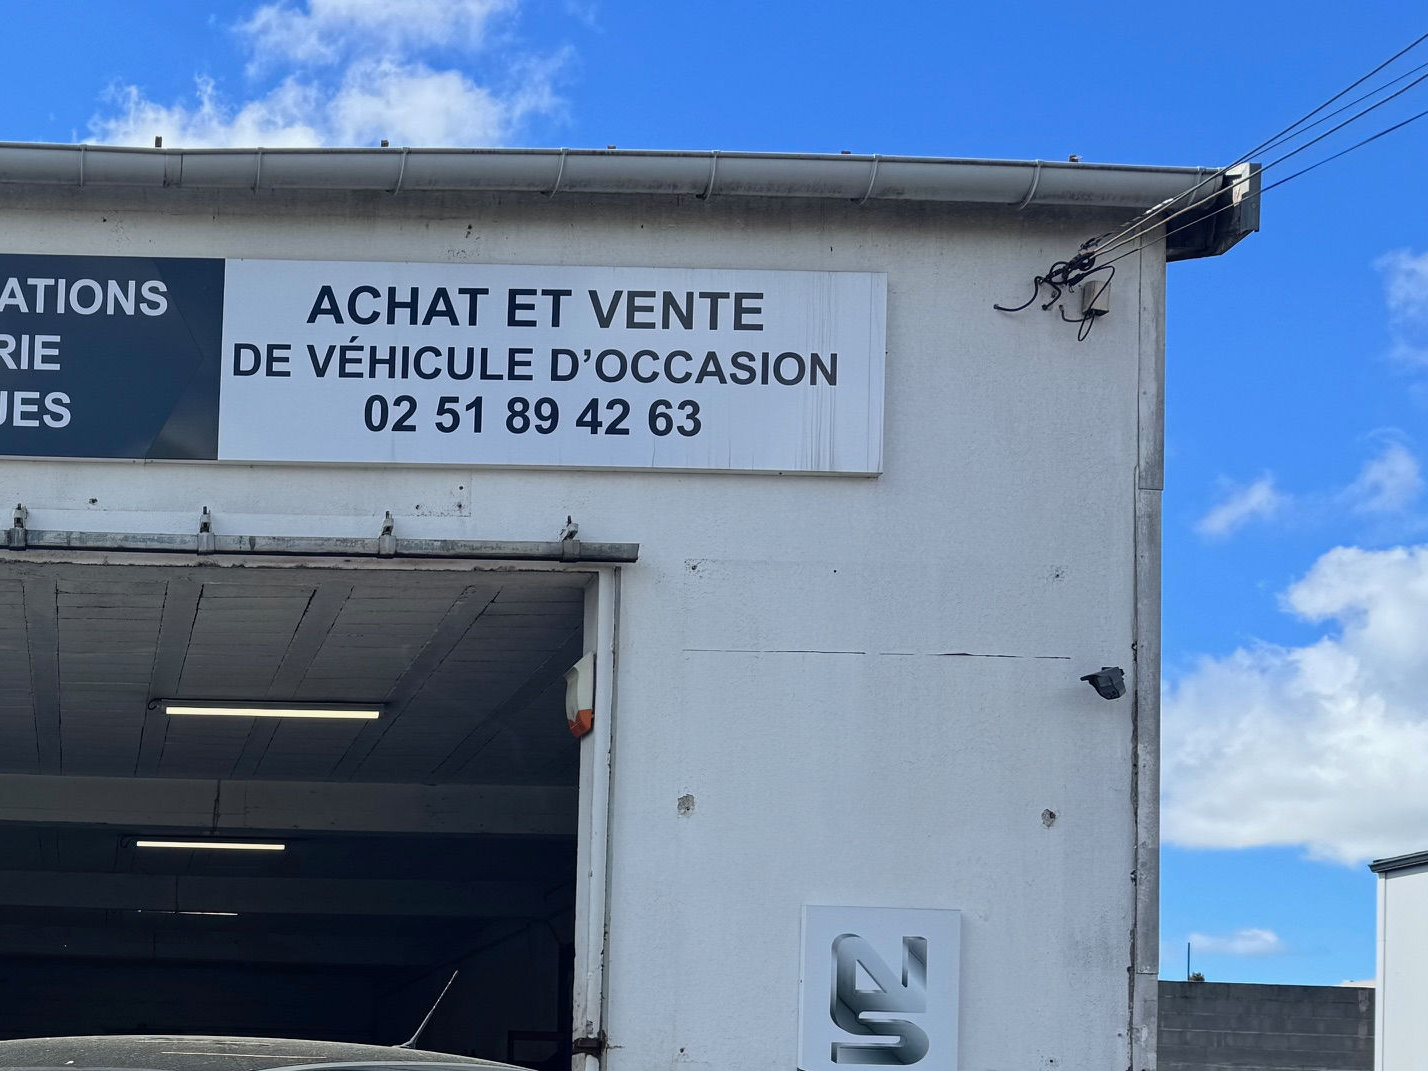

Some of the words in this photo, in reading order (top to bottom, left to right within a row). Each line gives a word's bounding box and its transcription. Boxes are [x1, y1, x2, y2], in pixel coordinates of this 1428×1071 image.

[307, 286, 489, 326] ACHAT
[507, 289, 572, 327] ET
[588, 290, 763, 331] VENTE
[233, 343, 291, 377] DE
[307, 336, 533, 380] VÉHICULE
[551, 349, 837, 386] D'OCCASION
[365, 395, 417, 432] 02
[435, 396, 482, 433] 51
[506, 397, 559, 434] 89
[576, 398, 630, 435] 42
[649, 399, 701, 437] 63
